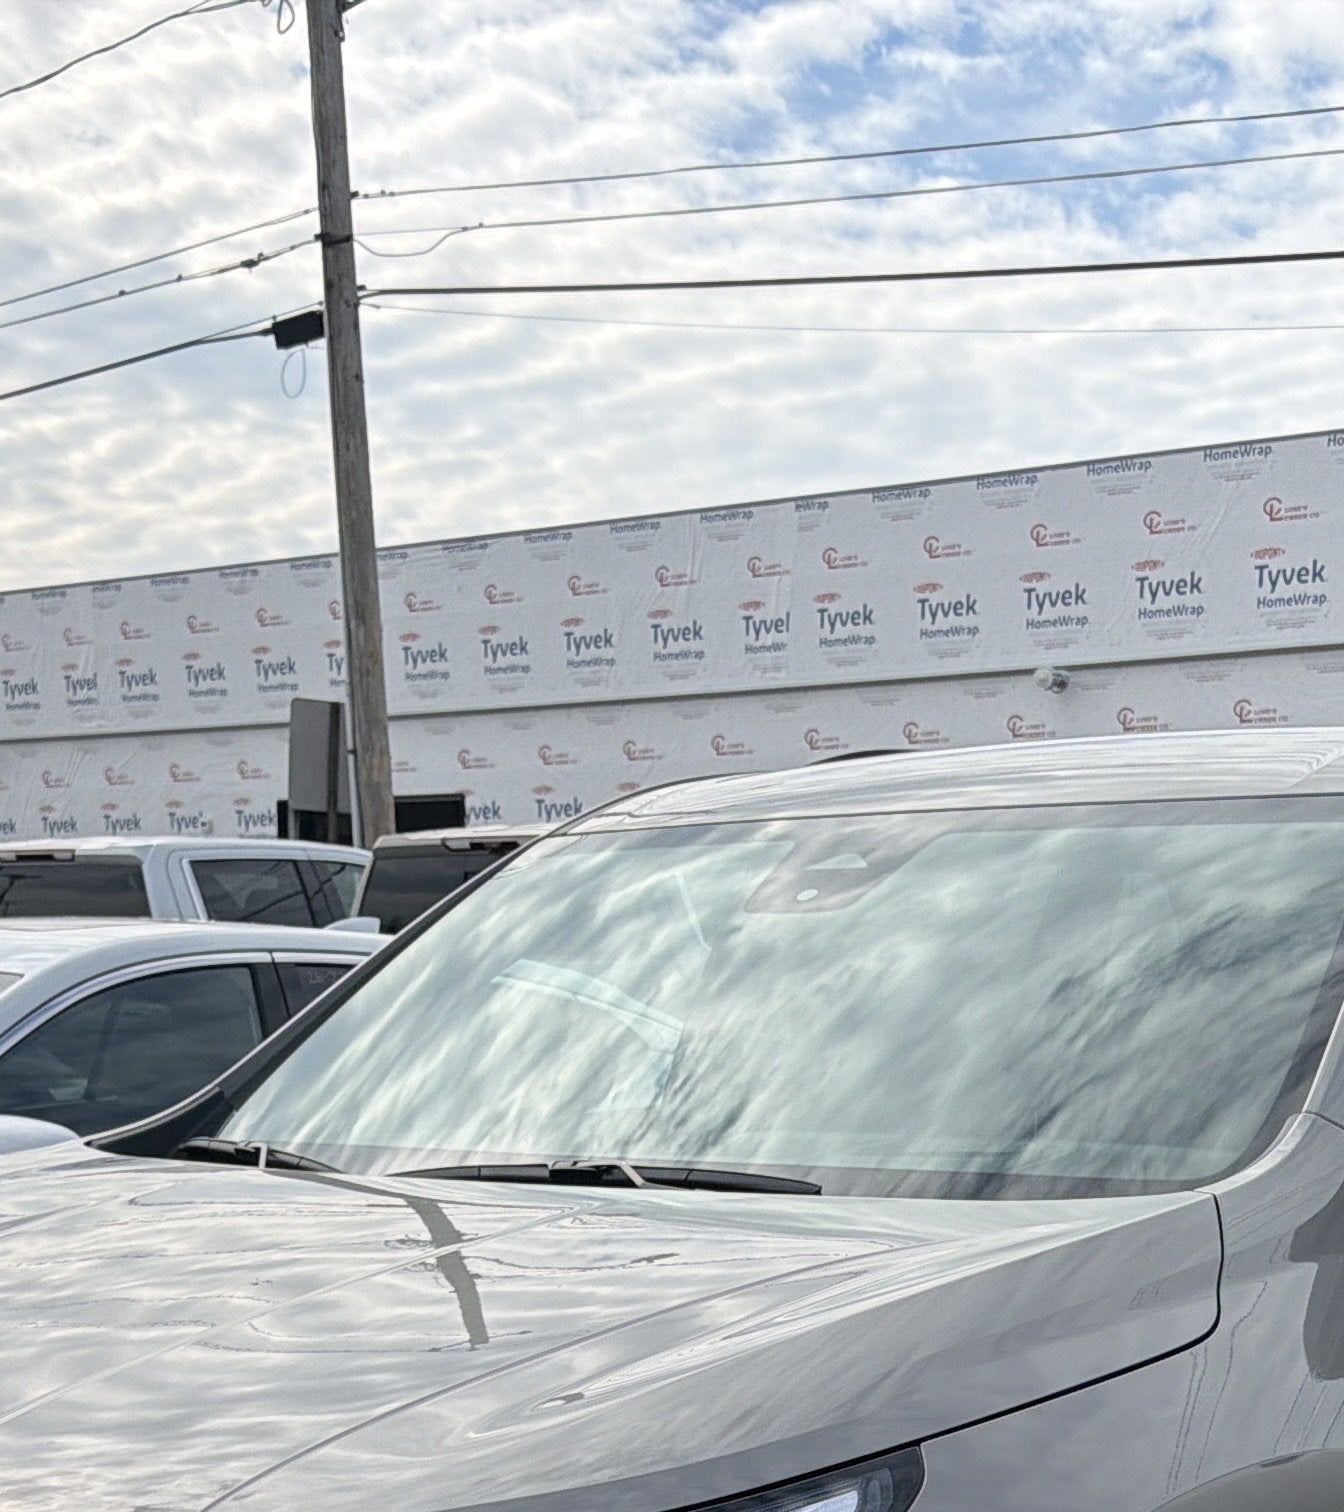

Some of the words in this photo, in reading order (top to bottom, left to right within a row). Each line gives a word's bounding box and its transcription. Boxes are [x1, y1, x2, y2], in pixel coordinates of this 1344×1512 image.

[1204, 444, 1273, 462] HomeWrap
[1087, 459, 1152, 477] HomeWrap
[1255, 559, 1325, 593] Tyvek
[1023, 583, 1087, 615] Tyvek
[1136, 571, 1202, 605] Tyvek
[917, 595, 977, 625] Tyvek
[1138, 604, 1204, 620] HomeWrap
[1257, 593, 1327, 609] HomeWrap
[817, 604, 873, 634] Tyvek
[1026, 615, 1089, 630] HomeWrap
[564, 629, 613, 655] Tyvek
[651, 621, 702, 649] Tyvek
[819, 635, 875, 648] HomeWrap
[920, 625, 980, 639] HomeWrap
[402, 643, 448, 669] Tyvek
[482, 636, 528, 662] Tyvek
[185, 663, 225, 686] Tyvek
[255, 656, 296, 680] Tyvek
[2, 679, 39, 700] Tyvek
[119, 669, 157, 692] Tyvek
[466, 801, 501, 821] yvek
[41, 817, 77, 836] Tyvek
[104, 814, 141, 833] Tyvek
